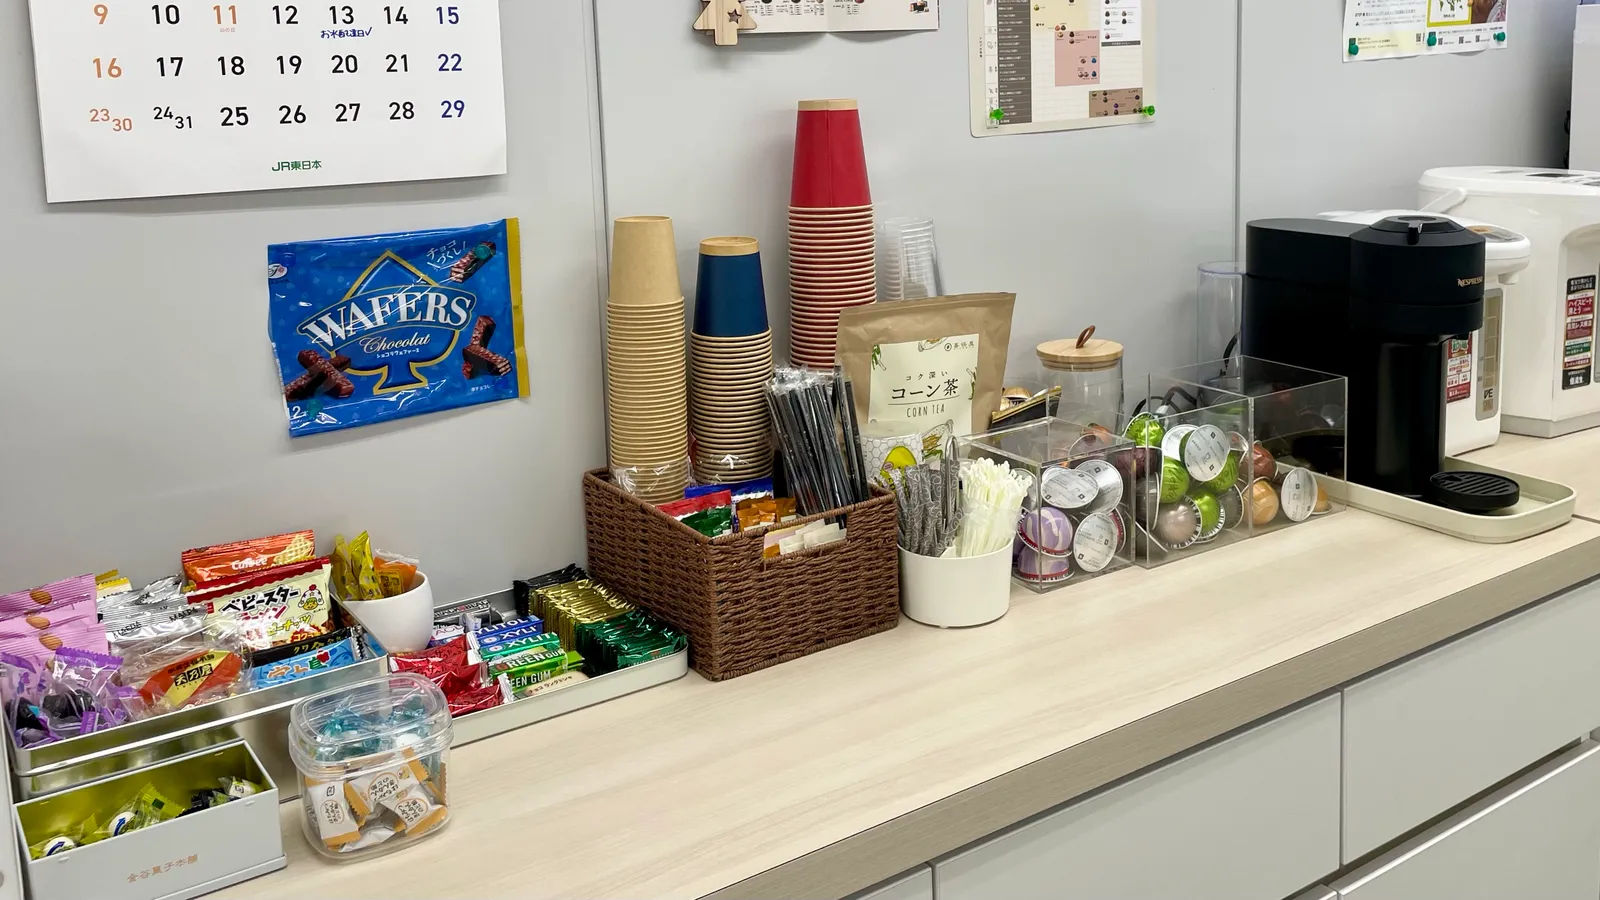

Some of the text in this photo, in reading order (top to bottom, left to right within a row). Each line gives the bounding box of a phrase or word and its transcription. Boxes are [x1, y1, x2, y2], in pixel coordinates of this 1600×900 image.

[94, 5, 459, 25] 9 10 11 12 13 14 15
[93, 53, 462, 78] 16 17 18 19 20 21 22
[90, 100, 465, 131] 23 30 24 31 25 26 27 28 29
[272, 160, 322, 171] JR東日本
[427, 240, 456, 260] チョコ
[302, 292, 471, 347] WAFERS
[359, 332, 431, 354] Chocolat
[906, 371, 948, 381] コク深い
[892, 378, 958, 399] コーン茶
[907, 404, 945, 418] CORN TEA
[221, 586, 299, 612] ベビースター
[475, 617, 528, 636] YLITOL
[174, 664, 213, 686] 天乃屋
[530, 670, 551, 684] GUM
